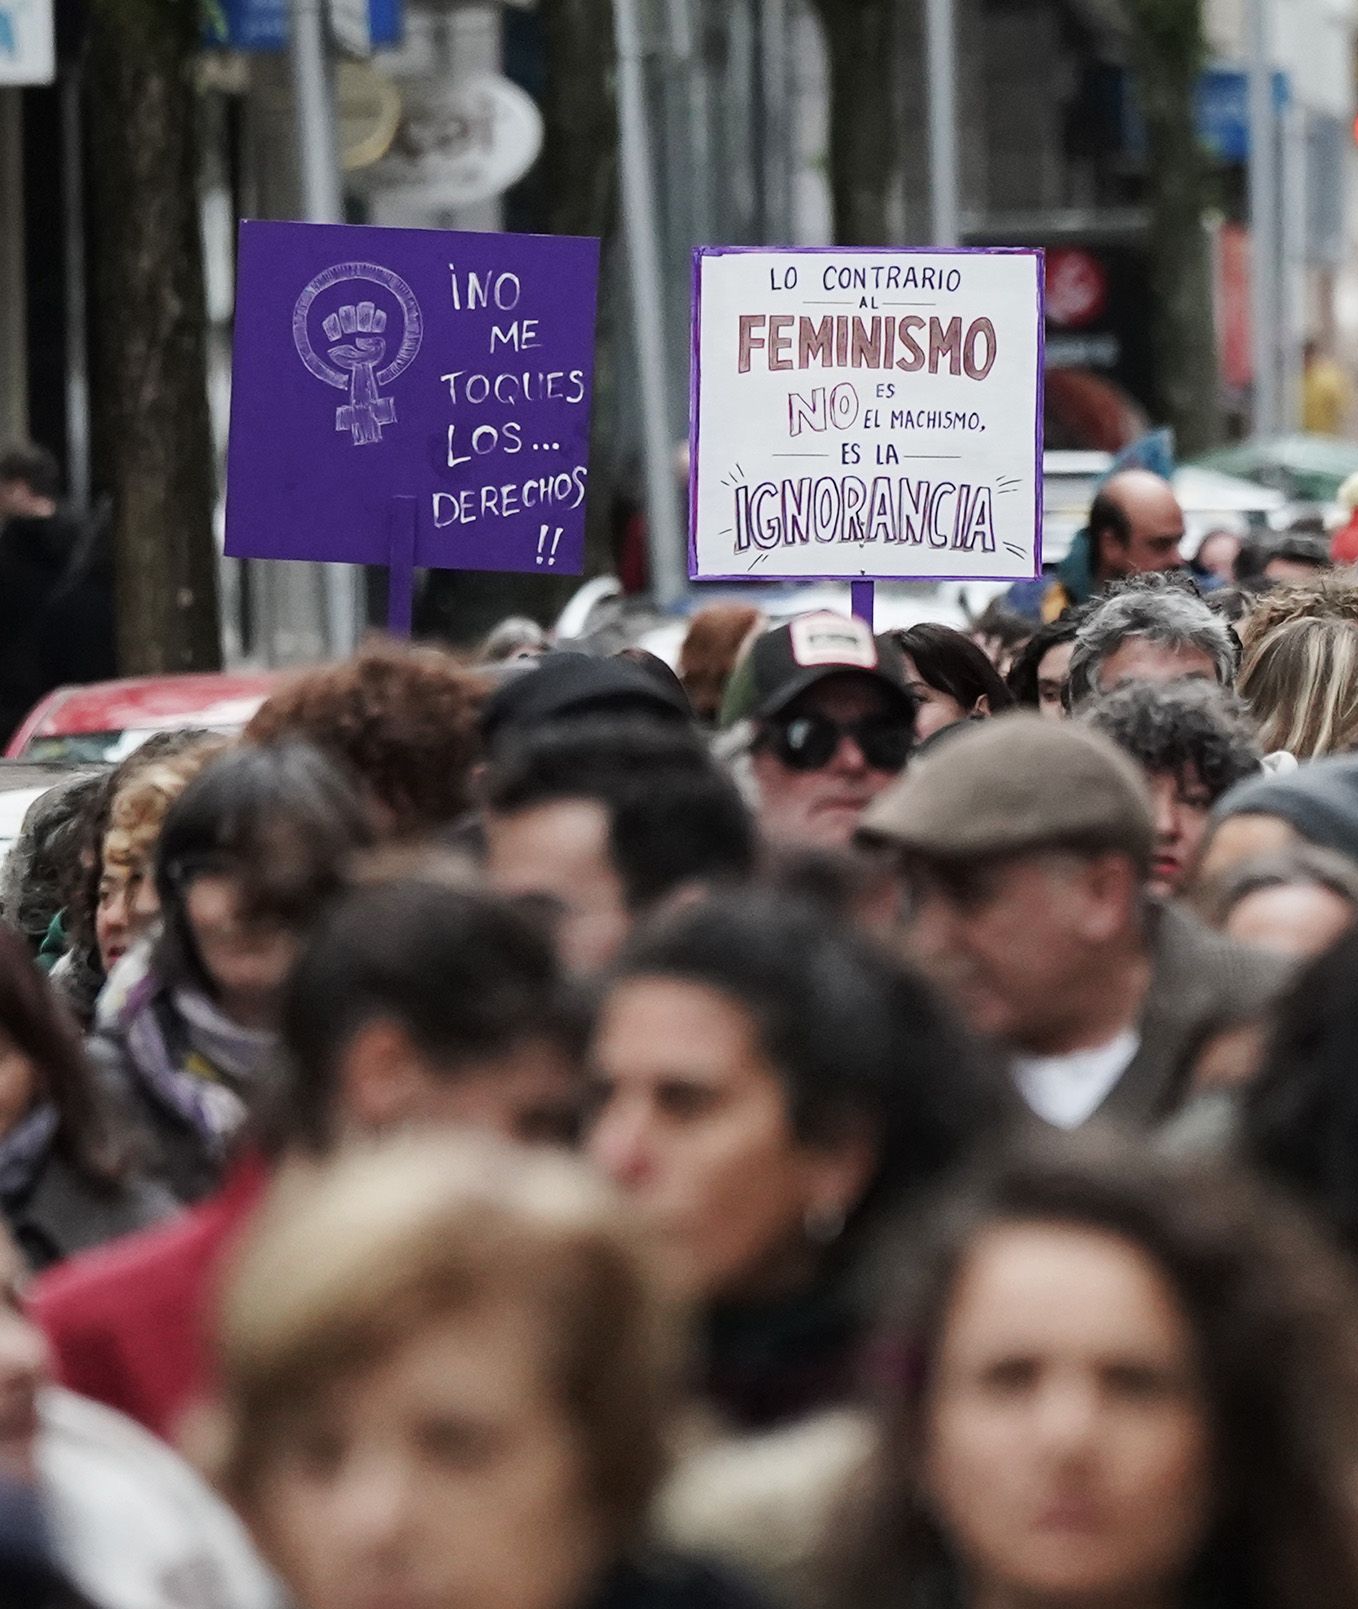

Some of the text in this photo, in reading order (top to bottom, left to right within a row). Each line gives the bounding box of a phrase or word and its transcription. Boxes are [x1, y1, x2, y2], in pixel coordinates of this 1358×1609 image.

[769, 265, 962, 292] LO CONTRARIO
[858, 296, 879, 310] AL
[489, 319, 543, 354] ME
[738, 314, 997, 381] FEMINISMO
[440, 369, 585, 405] TOQUES
[788, 382, 896, 437] NO ES
[863, 409, 987, 432] EL MACHISMO,
[446, 422, 560, 467] LOS...
[841, 442, 900, 465] ES LA
[432, 466, 588, 528] DERECHOS
[733, 475, 997, 554] IGNORANCIA
[535, 524, 564, 566] !!
